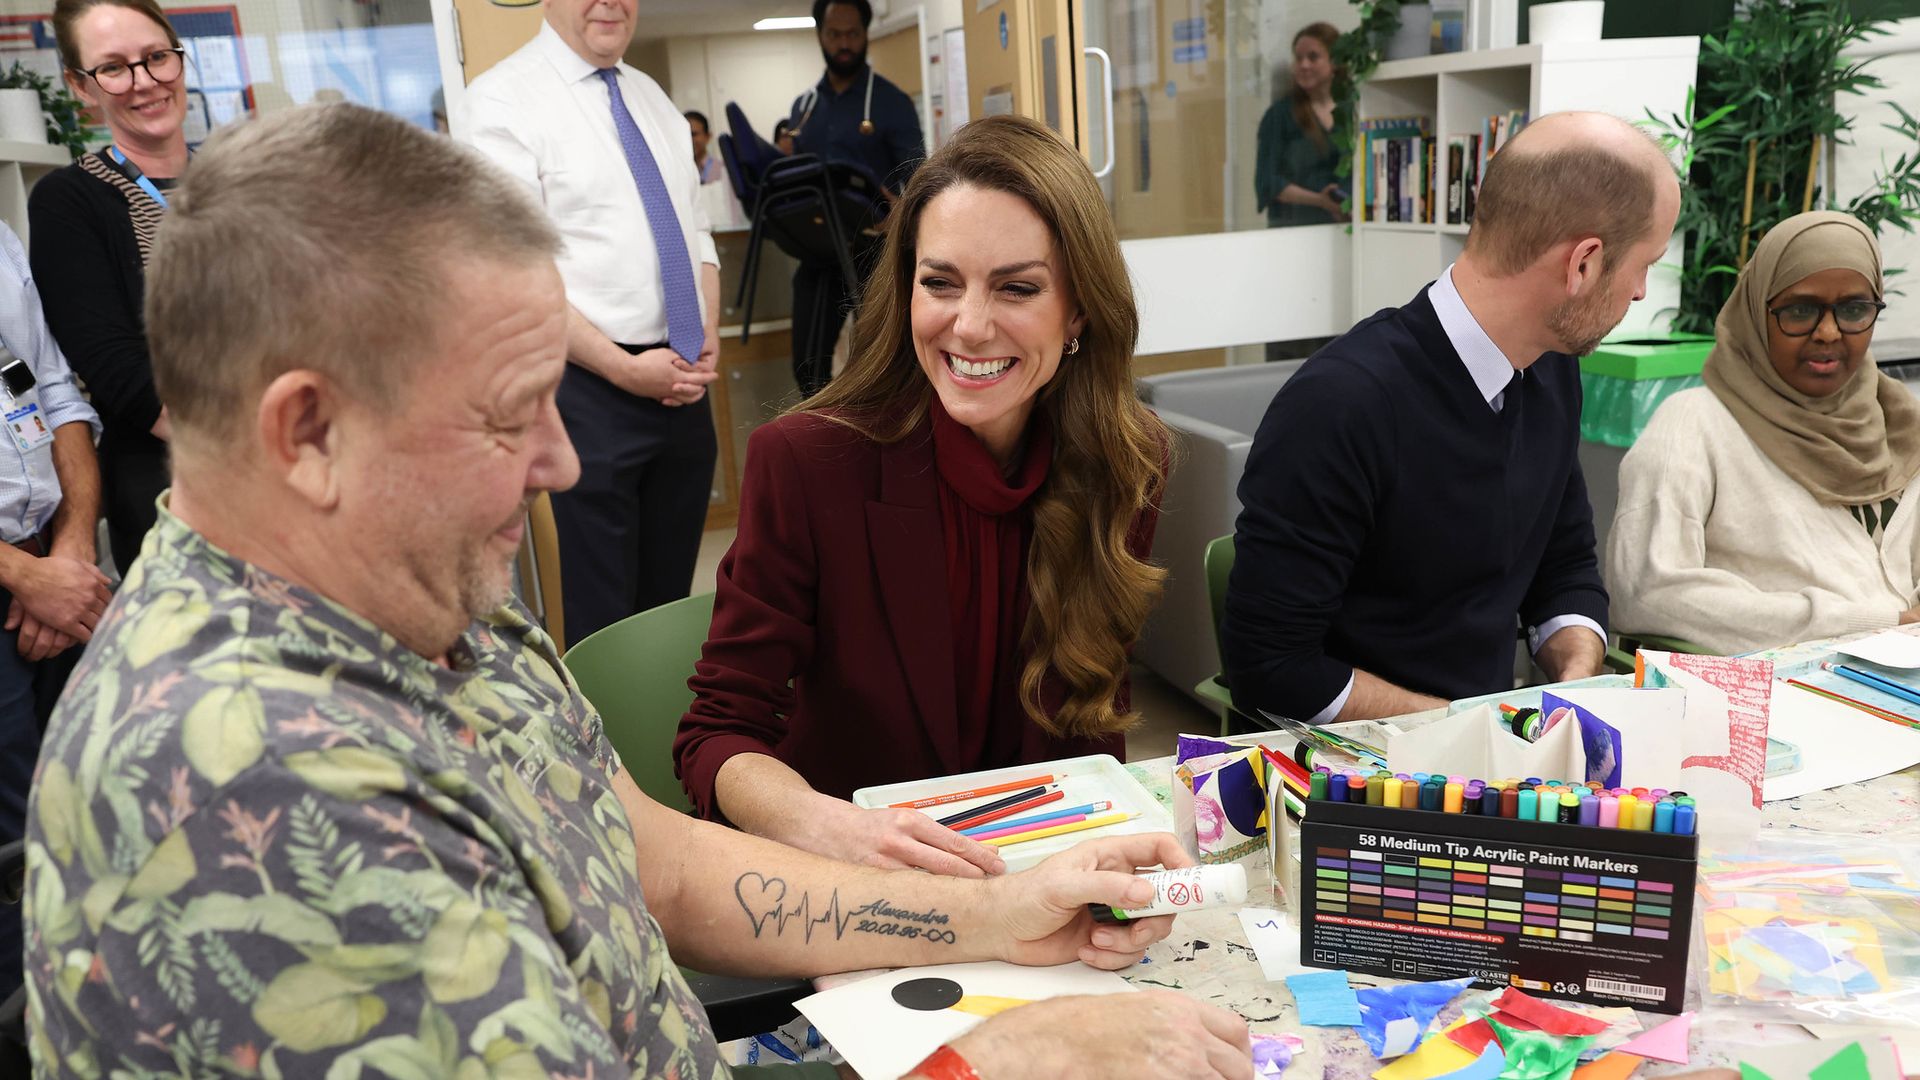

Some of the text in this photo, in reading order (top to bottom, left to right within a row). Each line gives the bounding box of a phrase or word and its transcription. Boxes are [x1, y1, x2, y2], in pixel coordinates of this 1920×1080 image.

[1358, 834, 1639, 874] 58 Medium Tip Acrylic Paint Markers
[859, 898, 950, 925] Alexandra
[1347, 918, 1372, 926] CHOKING
[1413, 926, 1427, 934] parts
[1448, 930, 1469, 938] children
[1489, 972, 1508, 980] ASTM
